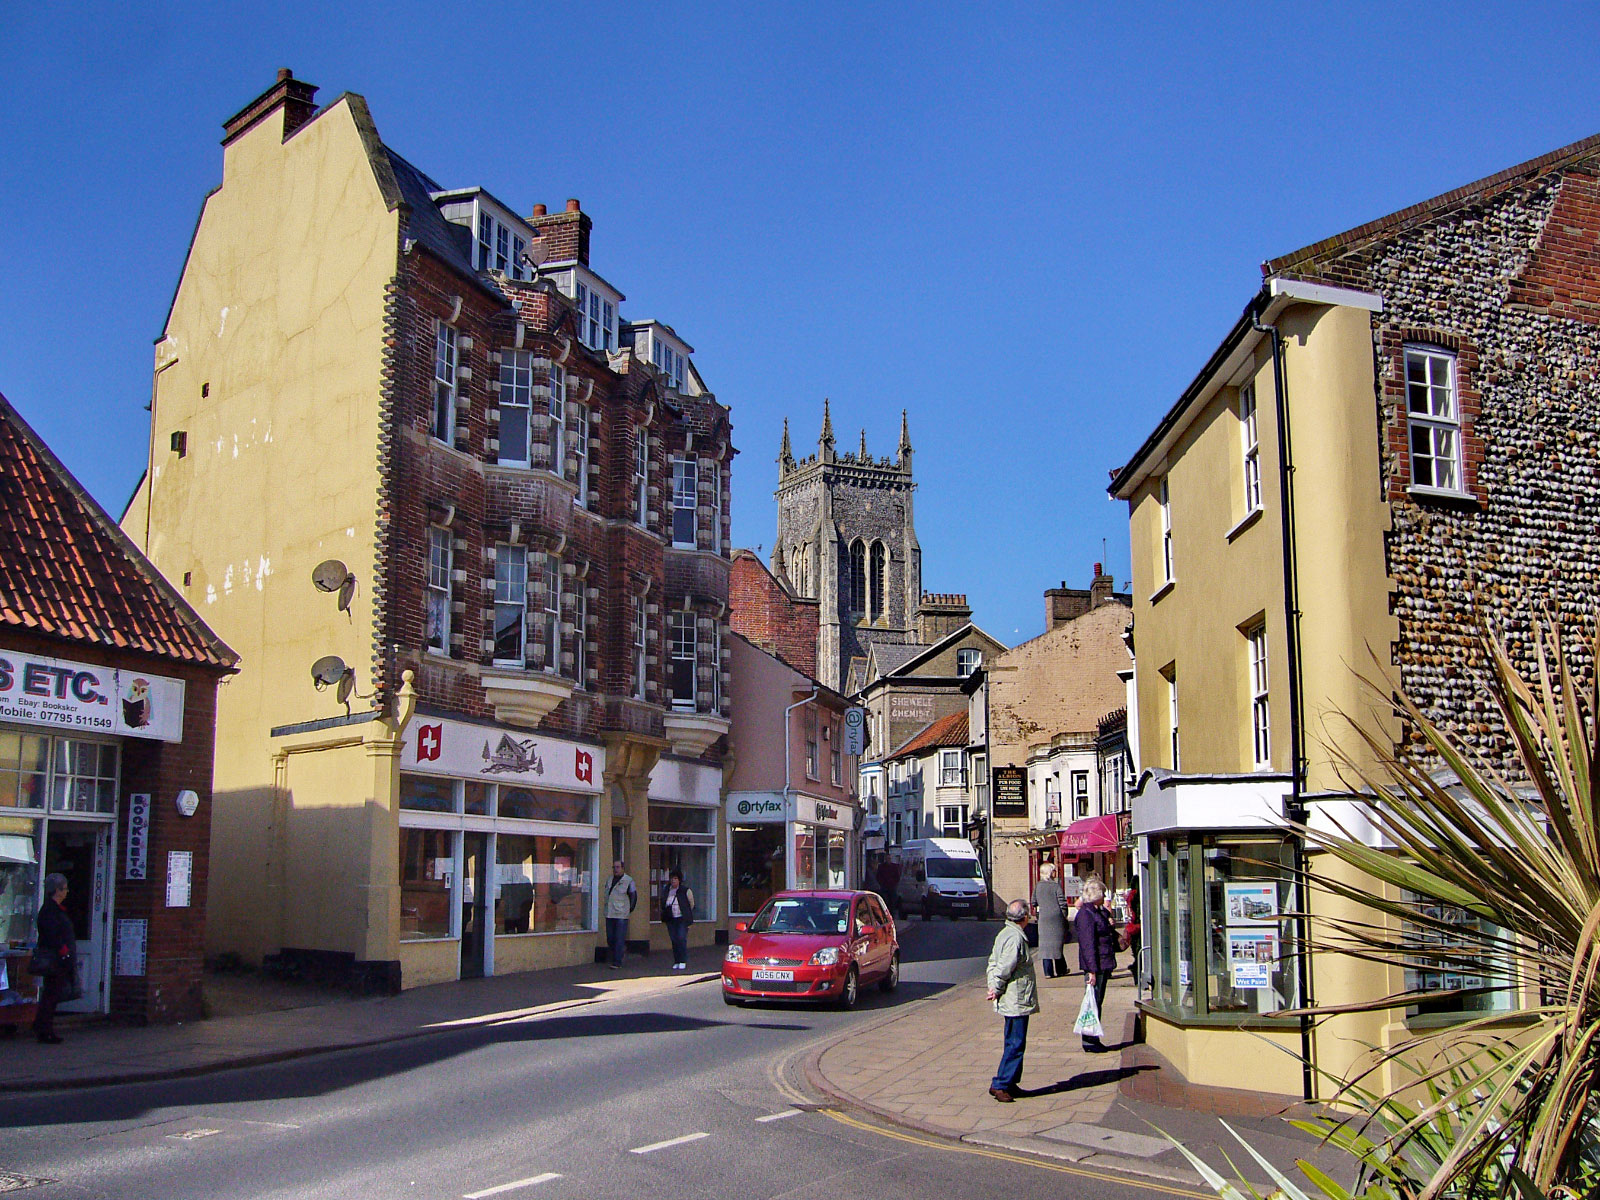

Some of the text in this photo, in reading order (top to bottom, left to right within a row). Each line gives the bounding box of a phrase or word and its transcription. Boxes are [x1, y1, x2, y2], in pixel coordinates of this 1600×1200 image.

[23, 662, 108, 705] ETC.
[18, 697, 40, 708] Ebay:
[40, 710, 72, 723] 07795
[75, 715, 112, 728] 511549
[892, 708, 931, 717] CHEMIST
